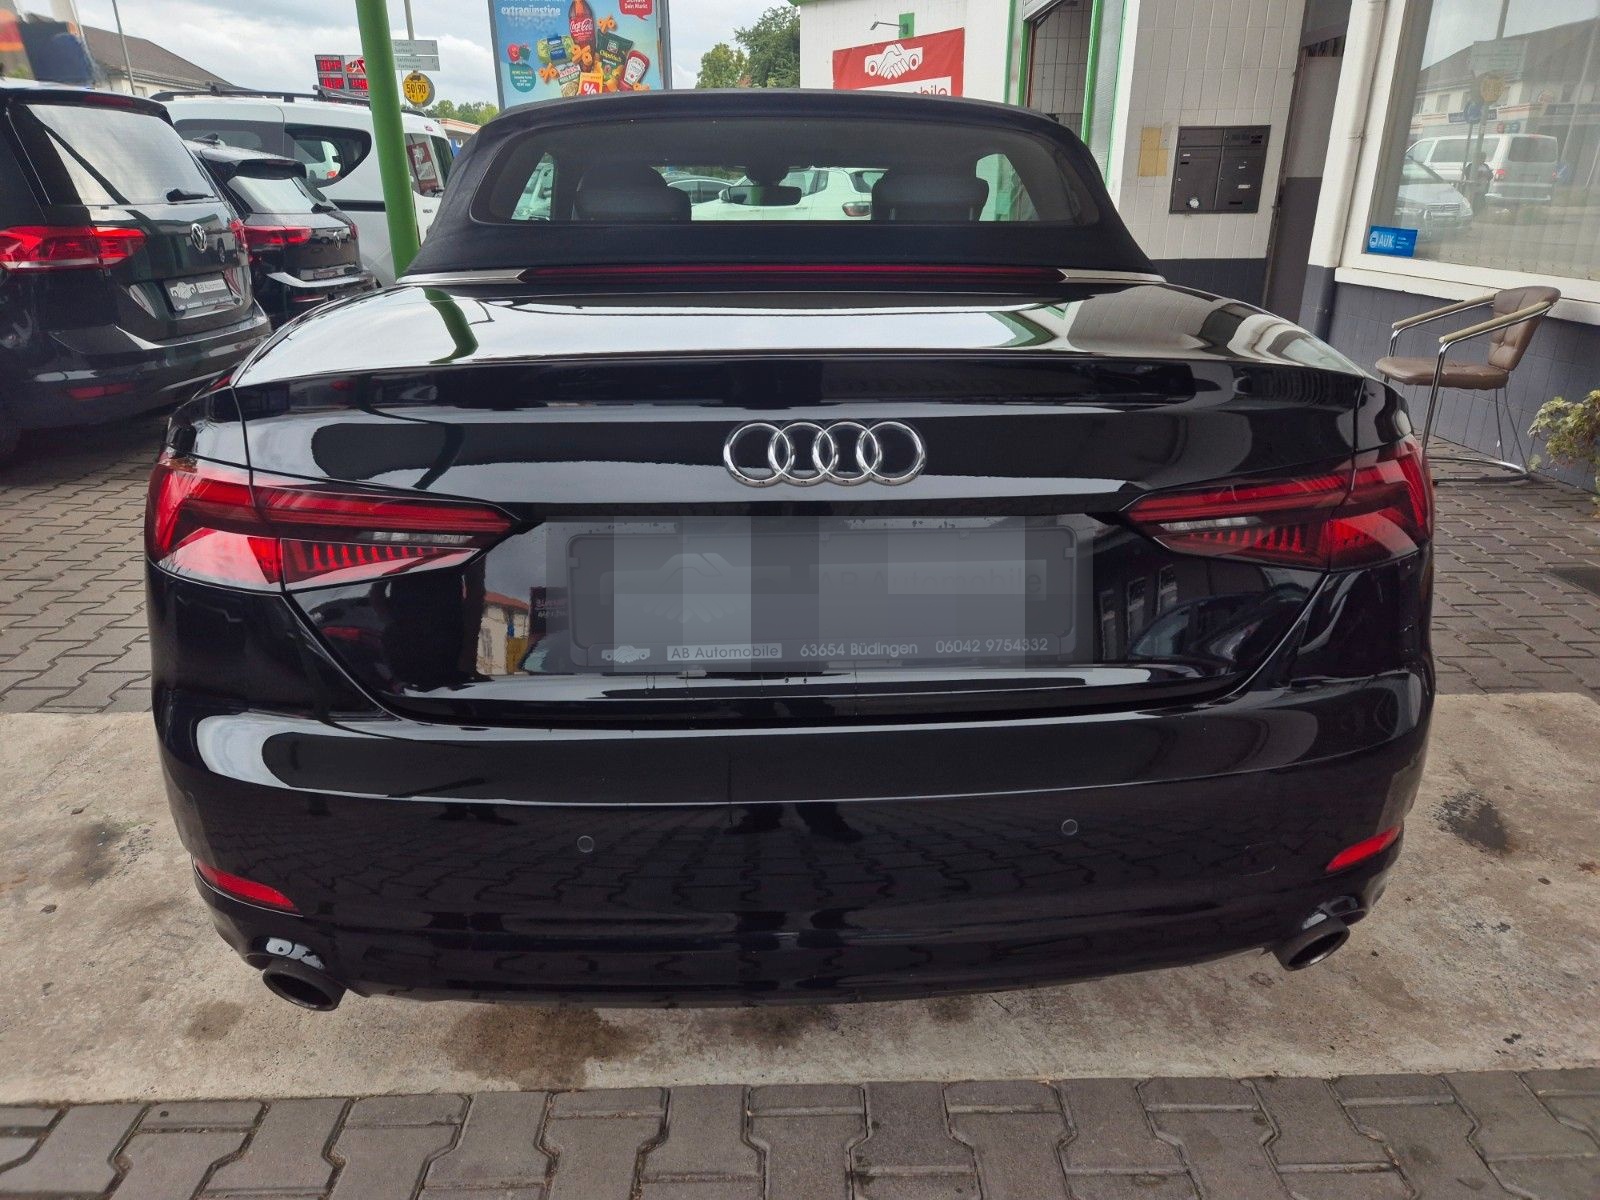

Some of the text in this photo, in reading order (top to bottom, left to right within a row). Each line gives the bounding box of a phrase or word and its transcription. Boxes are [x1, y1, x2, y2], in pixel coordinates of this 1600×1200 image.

[406, 83, 426, 94] 50 90
[912, 84, 948, 95] bile
[671, 645, 780, 660] AB Automobile
[800, 638, 1049, 658] 63654 Büdingen 06042 9754332
